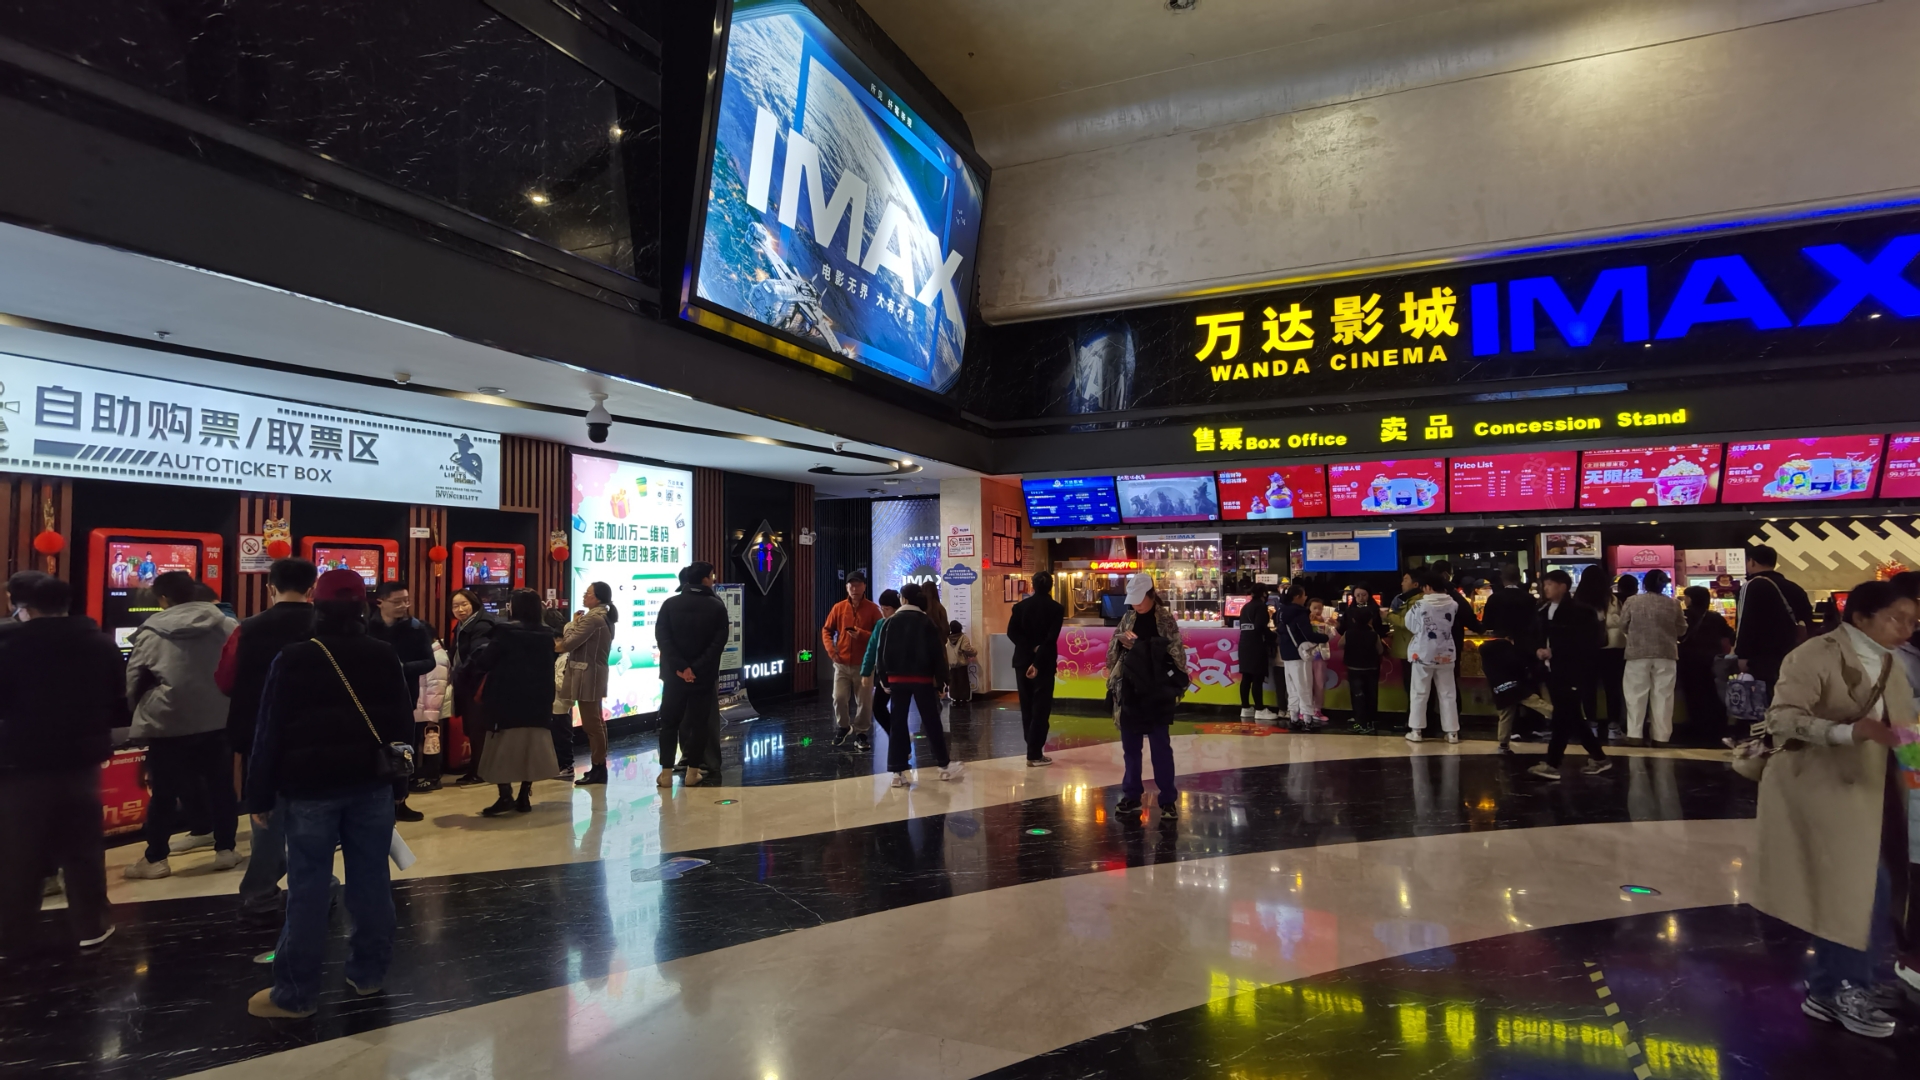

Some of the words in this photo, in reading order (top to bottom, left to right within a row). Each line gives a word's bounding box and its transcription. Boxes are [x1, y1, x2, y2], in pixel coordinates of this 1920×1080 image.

[746, 105, 963, 325] IMAX
[821, 263, 869, 300] 电影无界
[876, 294, 914, 324] 大有不同
[1471, 238, 1920, 357] IMAX
[1194, 287, 1459, 362] 万达影城
[1210, 358, 1310, 382] WANDA
[1330, 345, 1448, 371] CINEMA
[34, 385, 380, 465] 自助购票/取票区
[1474, 415, 1602, 436] Concession
[1617, 408, 1687, 428] Stand
[1193, 426, 1243, 452] 售票
[1246, 436, 1280, 450] Box
[1287, 432, 1348, 449] Office
[157, 452, 289, 480] AUTOTICKET
[294, 466, 333, 484] BOX
[1454, 462, 1476, 470] Price
[1477, 460, 1494, 469] List
[1584, 468, 1643, 485] 无限续
[435, 493, 478, 501] INVINCIBILITY
[594, 522, 669, 543] 添加小万二维码
[582, 544, 679, 564] 万达影迷团独家福利
[1633, 554, 1660, 563] evian
[902, 574, 941, 587] IMAX
[744, 660, 784, 679] TOILET
